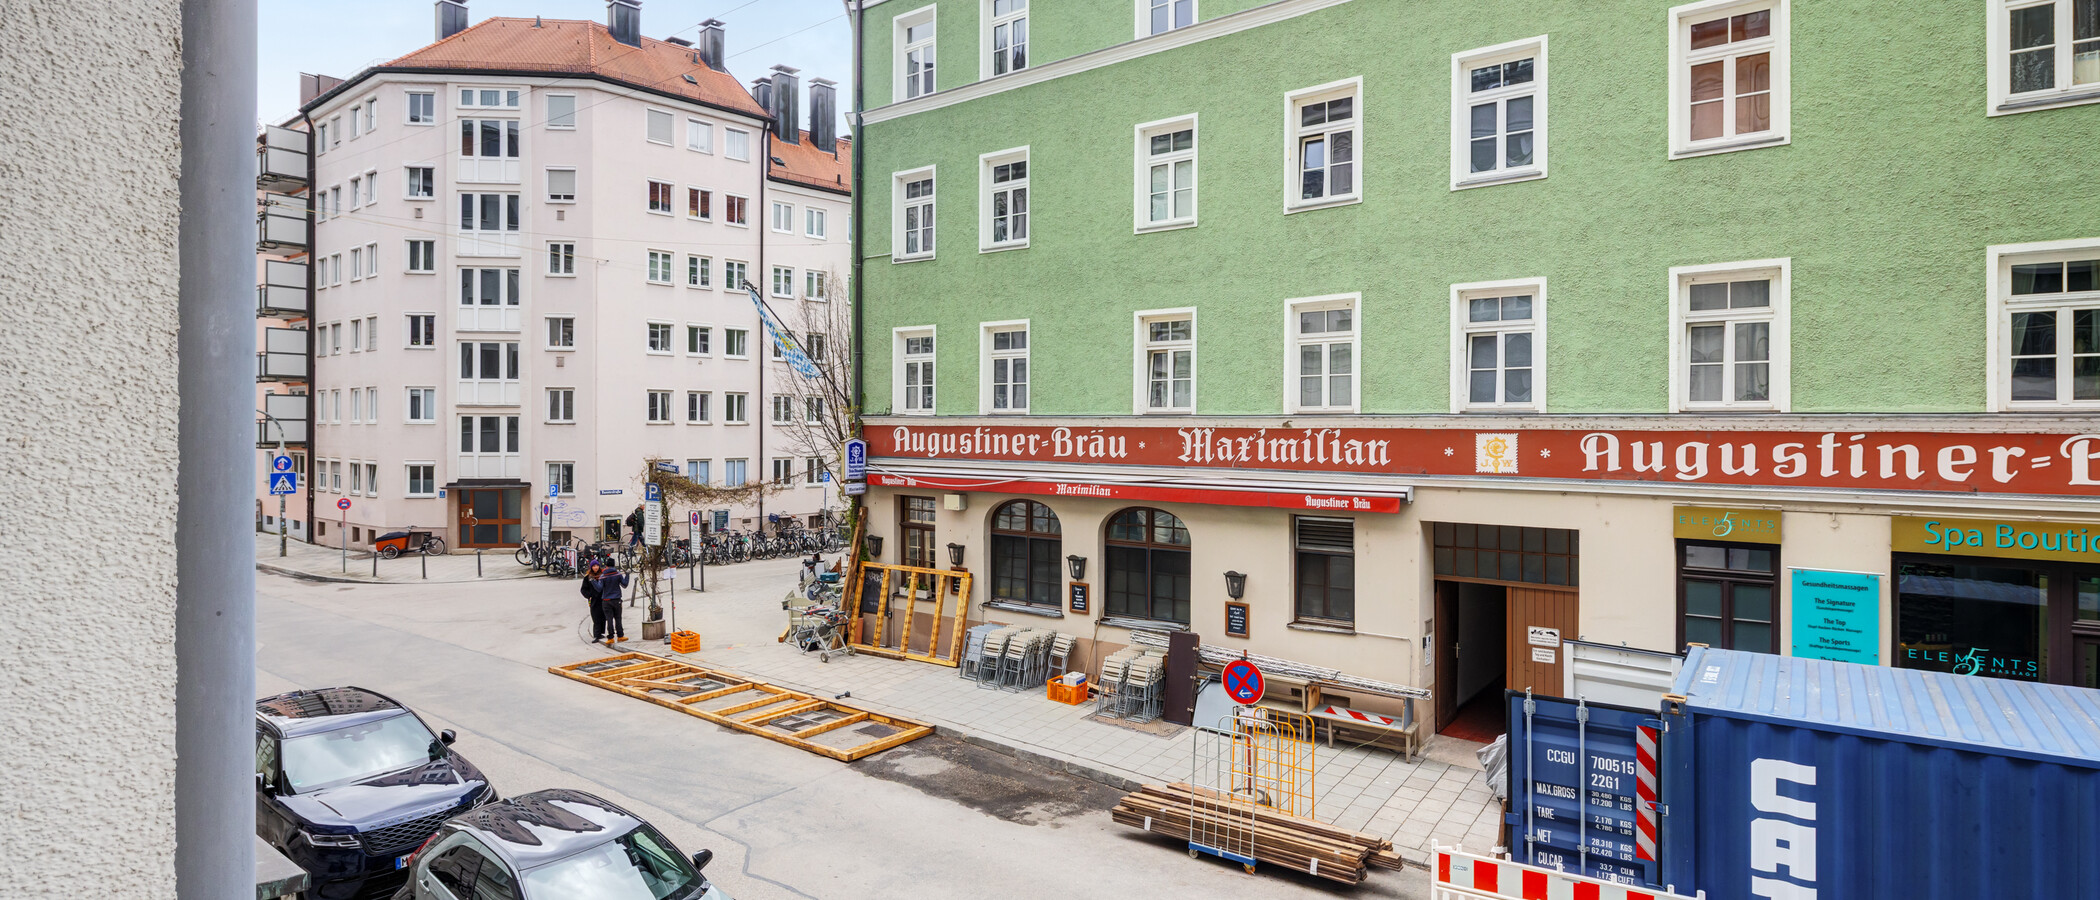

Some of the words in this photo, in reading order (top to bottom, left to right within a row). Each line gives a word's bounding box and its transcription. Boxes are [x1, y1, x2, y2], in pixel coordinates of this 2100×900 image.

[1177, 427, 1391, 467] Maximilian
[1056, 483, 1111, 496] Maximilian
[1305, 495, 1348, 509] Augustiner
[1353, 496, 1371, 510] Bräu
[1679, 515, 1775, 529] ELEMENTS
[1924, 520, 1984, 552] Spa
[1802, 580, 1869, 592] Gesundheitsmassagen
[1826, 598, 1856, 607] Signature
[1823, 617, 1834, 625] The
[1835, 618, 1846, 627] Top
[1819, 636, 1830, 644] The
[1830, 638, 1851, 646] Sports
[1908, 649, 2037, 671] ELEMENTS
[1990, 668, 2037, 678] MASSAGE
[1547, 748, 1575, 765] CCGU
[1591, 755, 1635, 775] 700515
[1591, 773, 1619, 791] 22G1
[1536, 782, 1576, 800] MAX.GROSS
[1619, 795, 1632, 804] KGS
[1591, 798, 1613, 808] 67.200
[1620, 802, 1633, 812] LBS
[1536, 806, 1555, 820] TARE
[1595, 815, 1613, 825] 2.170
[1619, 819, 1632, 829] KGS
[1620, 828, 1633, 836] LBS
[1537, 828, 1552, 844] NET
[1591, 837, 1613, 849] 28.310
[1620, 843, 1633, 853] KGS
[1591, 846, 1613, 858] 62.420
[1620, 852, 1633, 861] LBS
[1599, 862, 1613, 872] 33.2
